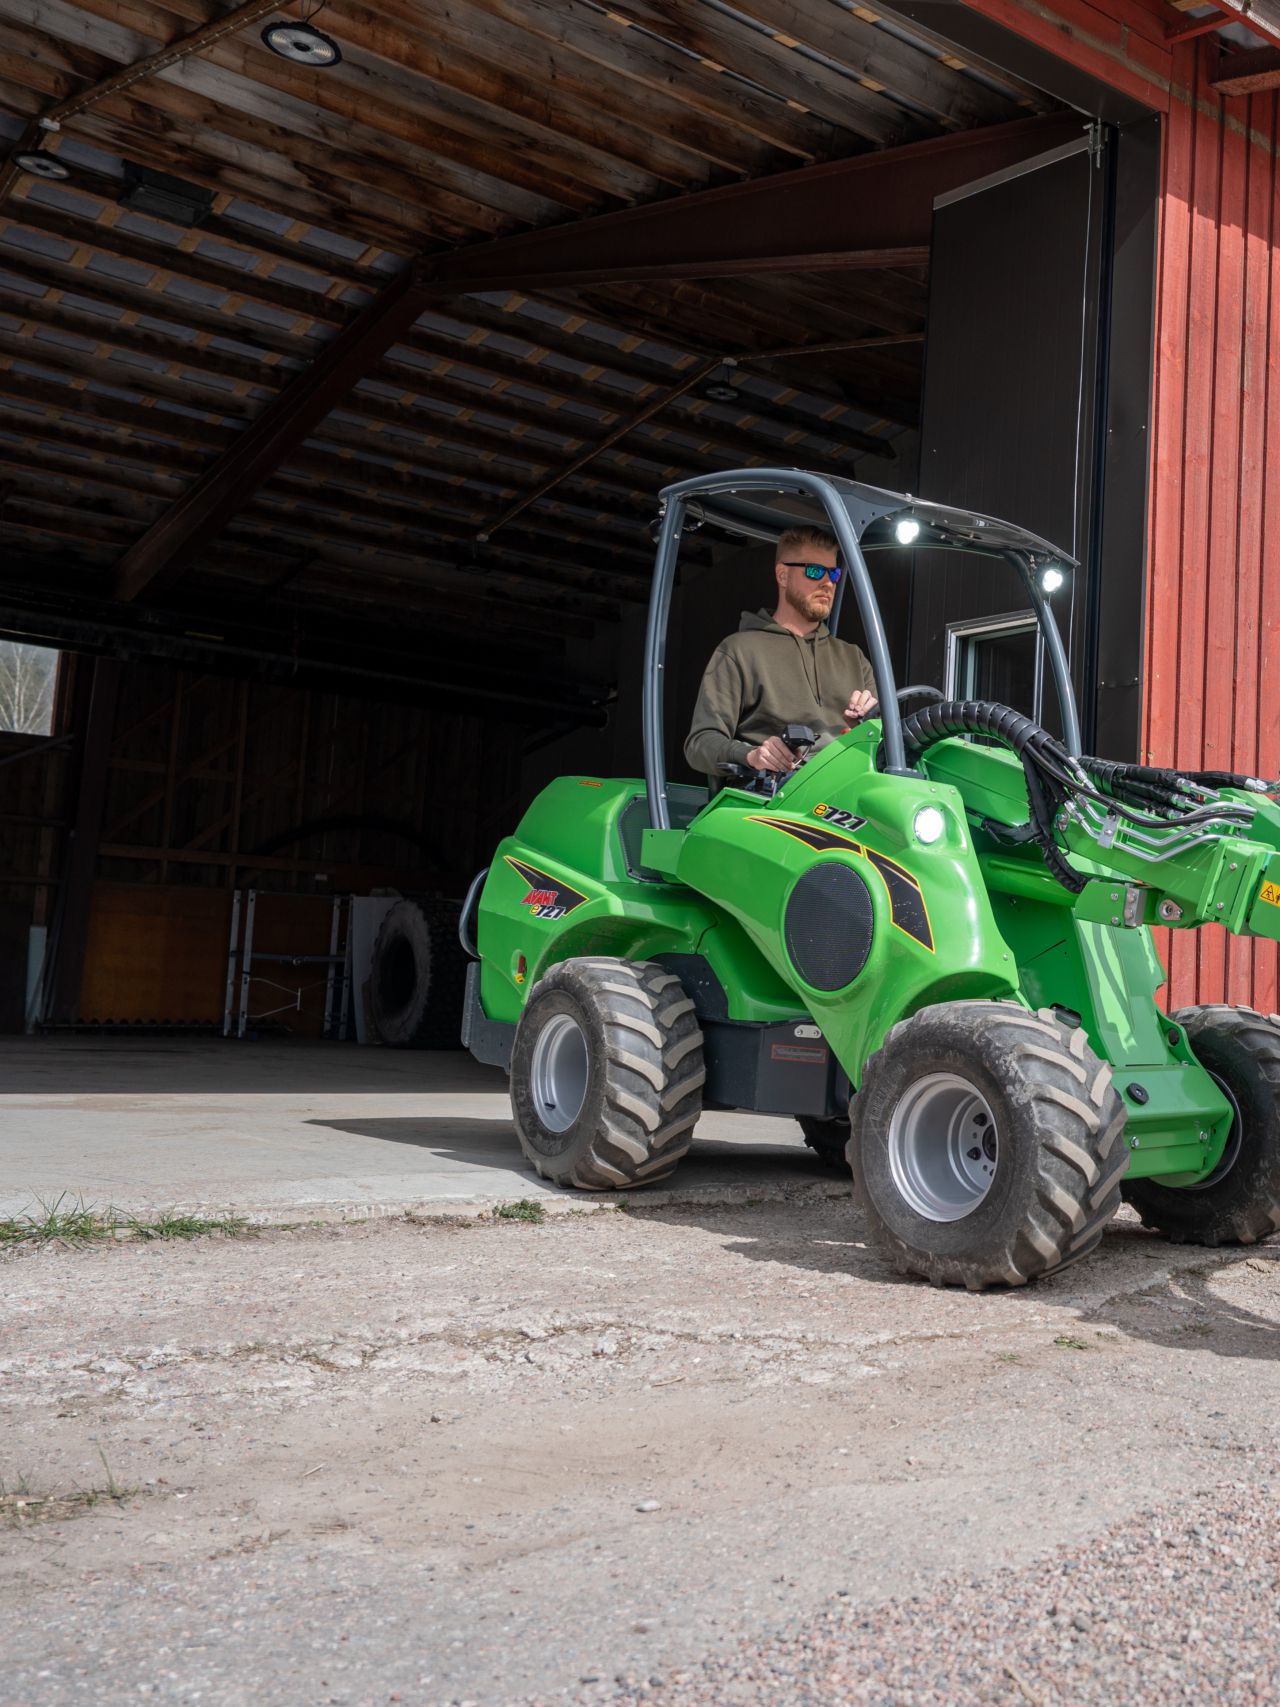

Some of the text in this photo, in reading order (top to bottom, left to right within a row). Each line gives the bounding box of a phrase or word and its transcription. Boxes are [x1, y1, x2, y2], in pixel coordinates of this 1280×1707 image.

[814, 803, 867, 832] e727
[520, 889, 558, 905] AVANT
[530, 904, 566, 920] e727
